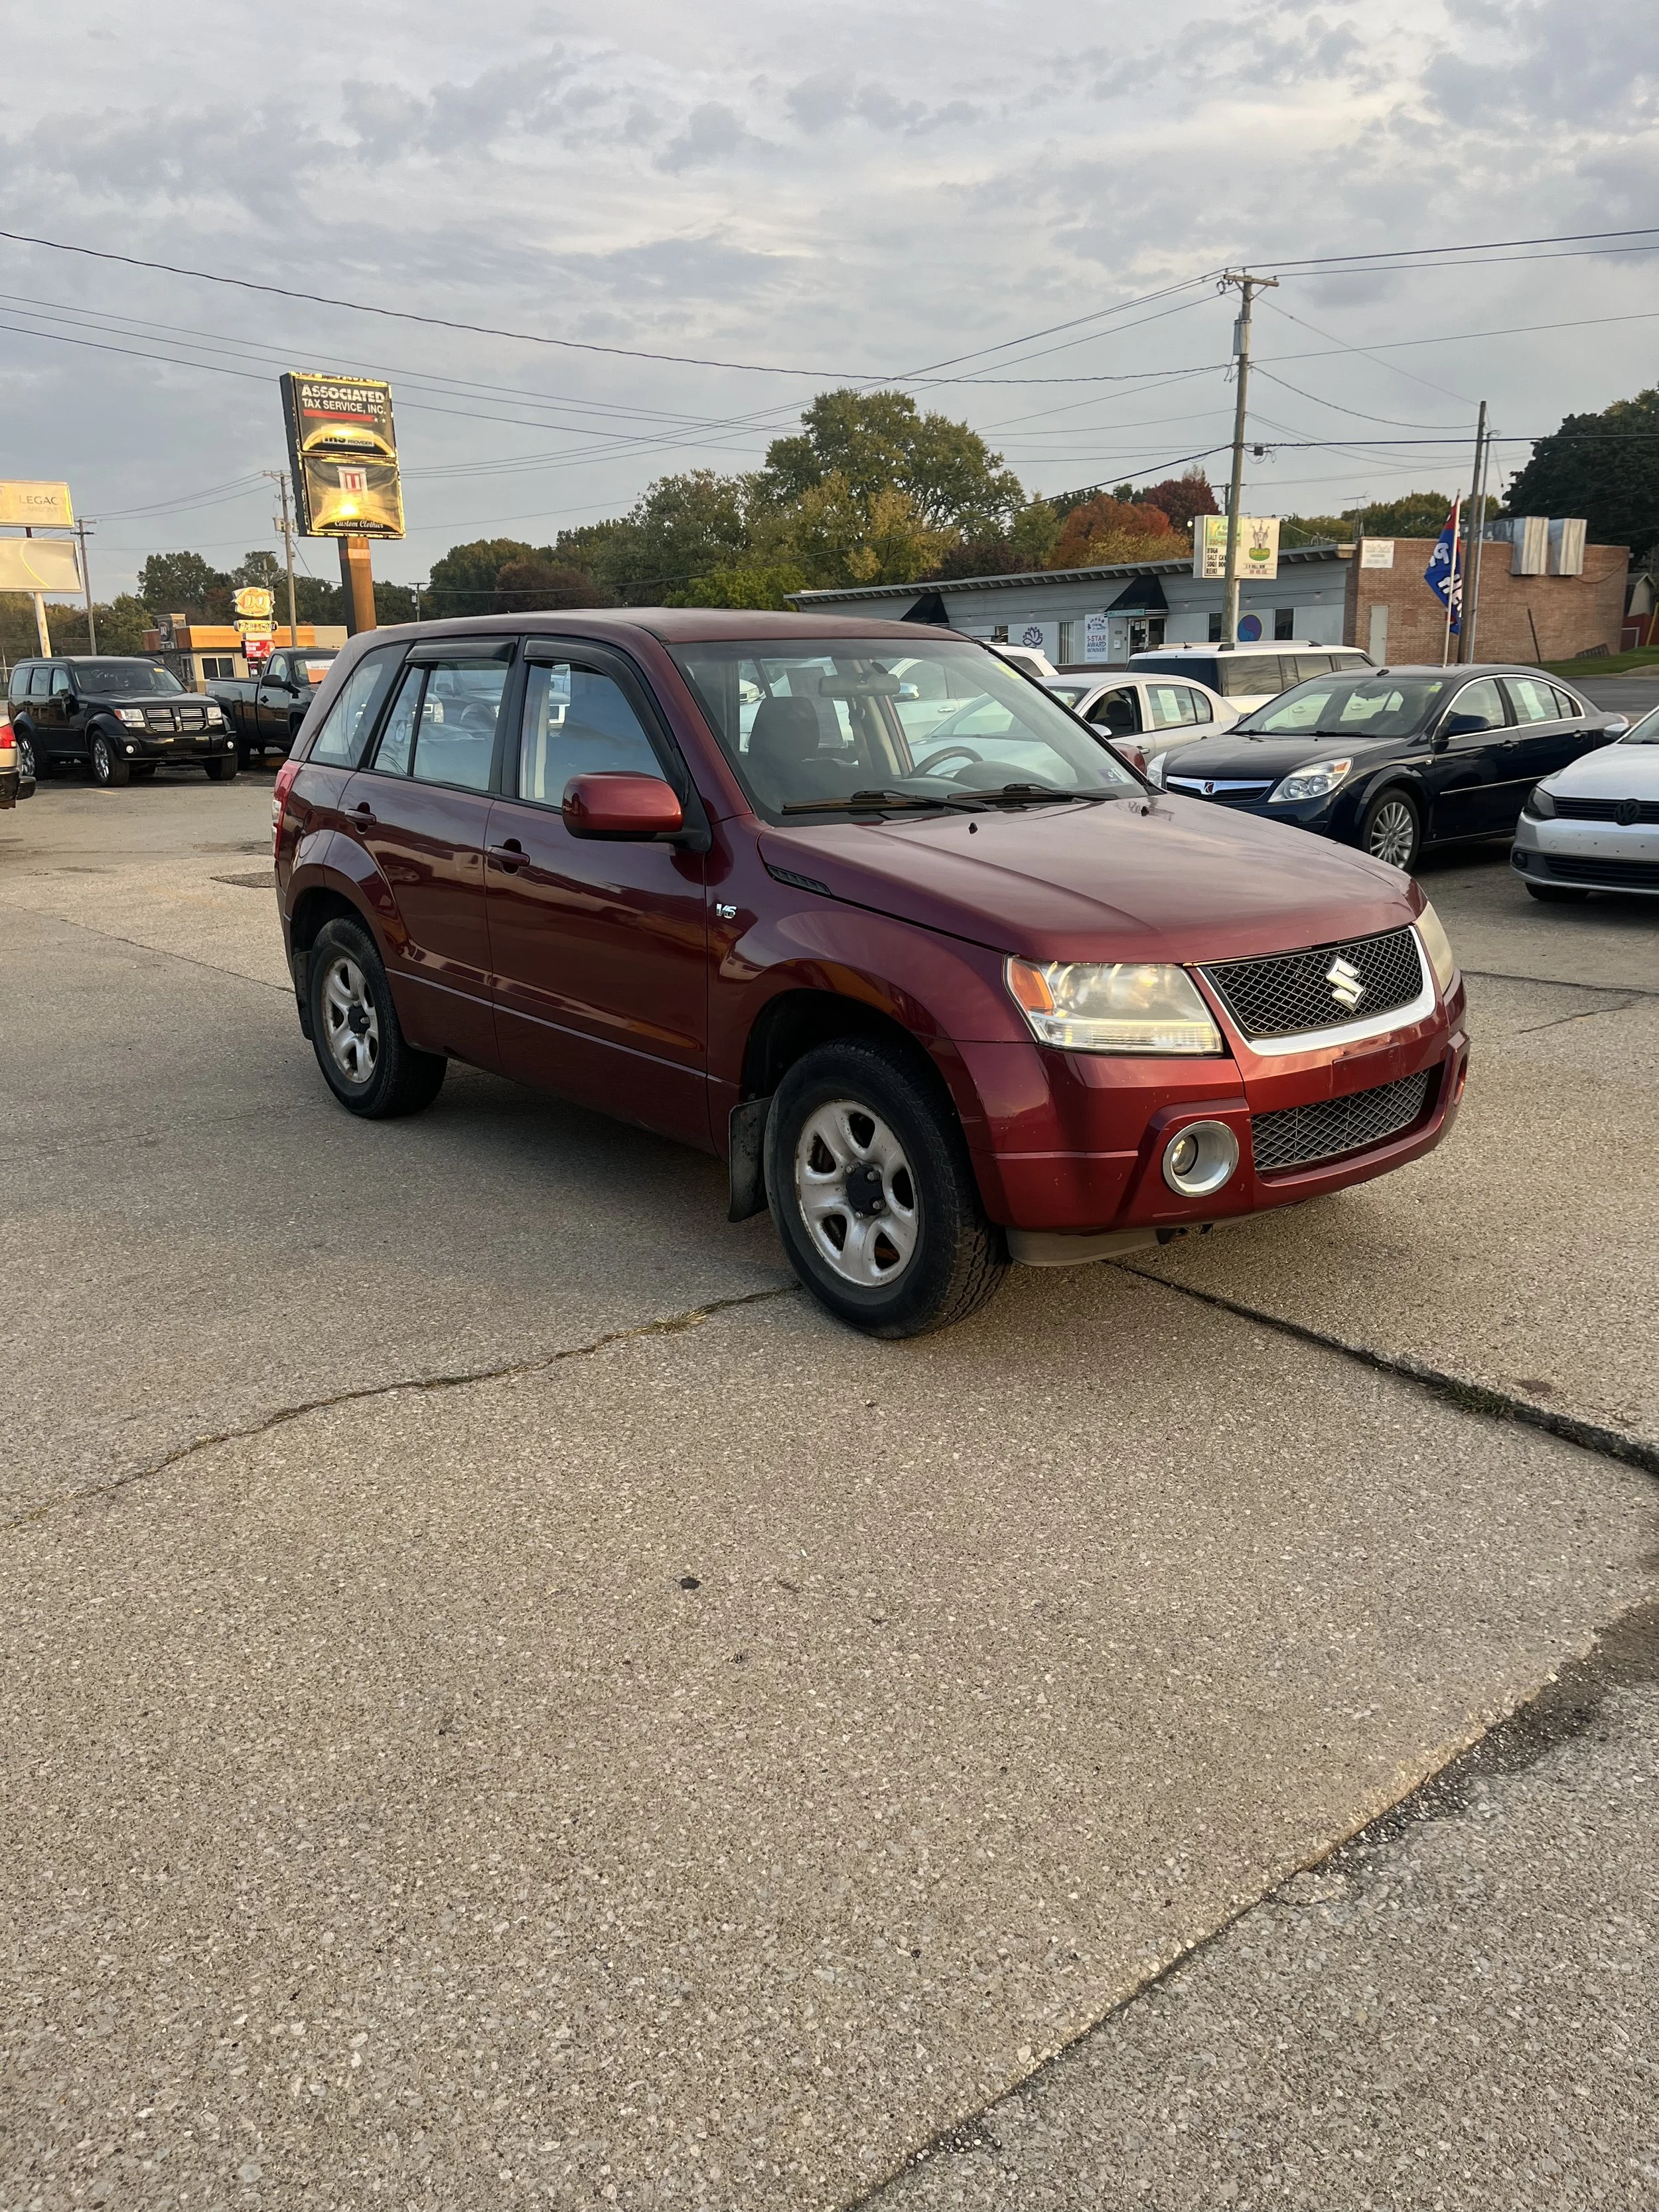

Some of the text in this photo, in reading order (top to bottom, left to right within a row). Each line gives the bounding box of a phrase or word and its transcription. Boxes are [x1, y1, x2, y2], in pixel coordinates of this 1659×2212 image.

[301, 384, 385, 403] ASSOCIATED
[302, 398, 386, 415] TAX SERVICE, INC.
[359, 520, 384, 529] Clothier
[243, 595, 271, 611] DQ
[716, 903, 737, 919] V6
